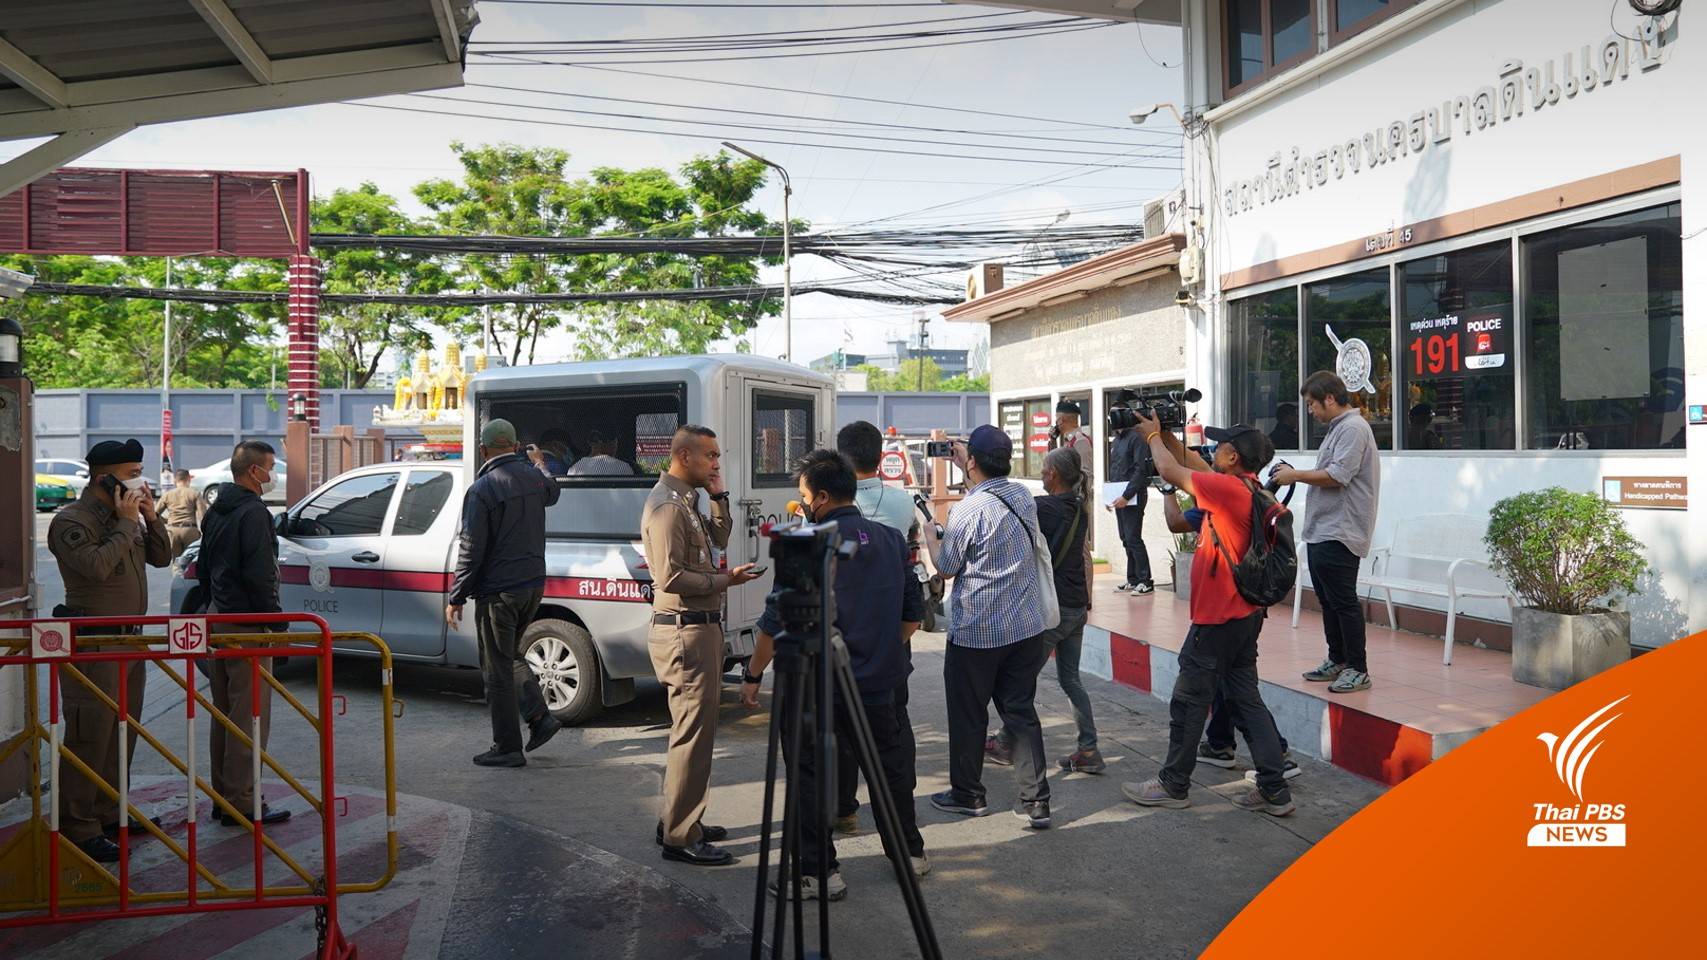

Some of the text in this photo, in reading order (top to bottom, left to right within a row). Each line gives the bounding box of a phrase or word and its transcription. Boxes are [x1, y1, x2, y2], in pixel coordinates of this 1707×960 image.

[1399, 228, 1413, 243] 45
[1467, 318, 1502, 333] POLICE
[1410, 332, 1459, 375] 191
[579, 576, 652, 599] สน.ดินแด
[303, 599, 339, 613] POLICE
